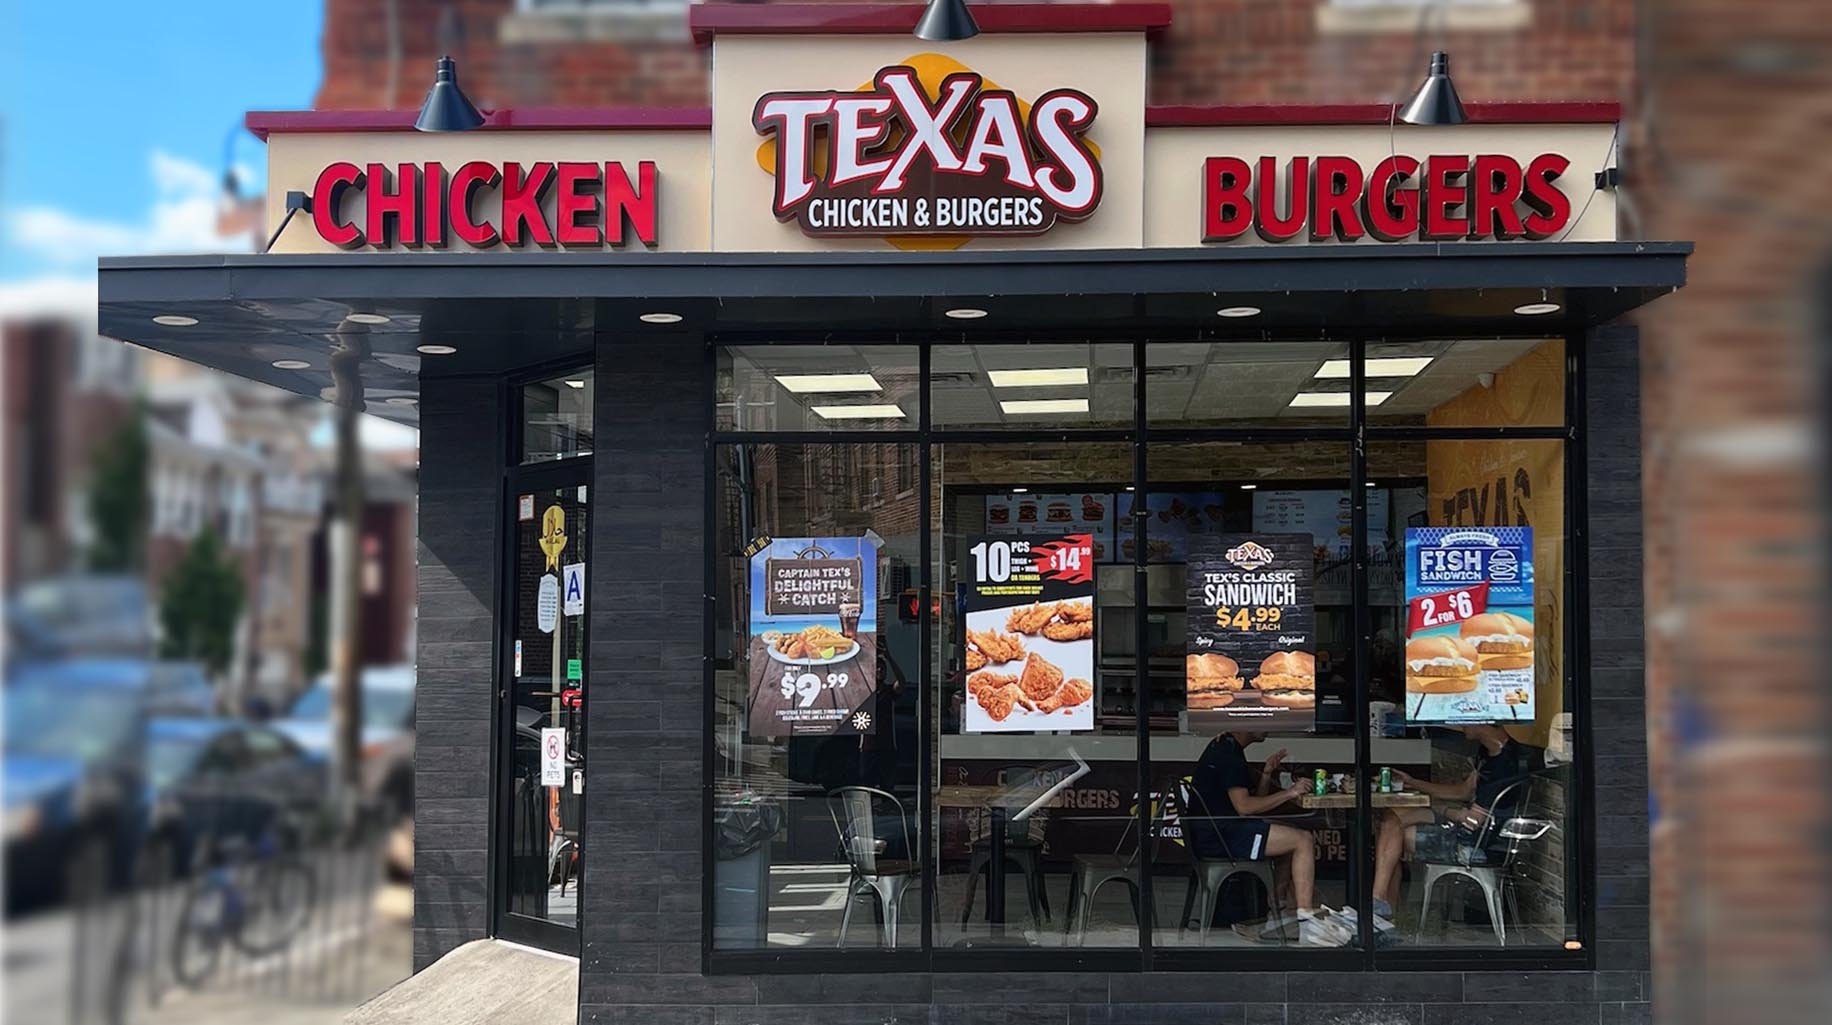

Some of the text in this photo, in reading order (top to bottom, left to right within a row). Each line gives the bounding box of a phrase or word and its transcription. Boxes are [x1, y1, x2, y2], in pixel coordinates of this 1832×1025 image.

[758, 71, 1099, 210] TEXAS
[312, 161, 659, 248] CHICKEN
[1202, 153, 1571, 242] BURGERS
[807, 196, 1044, 228] CHICKEN & BURGERS
[970, 541, 1030, 583] 10 PCS
[1226, 546, 1273, 564] TEXAS
[1420, 550, 1482, 571] FISH
[778, 567, 851, 578] CAPTAIN TEX'S
[1205, 573, 1296, 583] TEX'S CLASSIC
[1421, 571, 1482, 580] SANDWICH
[566, 571, 582, 602] A
[774, 579, 855, 593] DELIGHTFUL
[1204, 583, 1296, 606] SANDWICH
[791, 592, 836, 607] CATCH
[1421, 591, 1473, 626] 2 FOR $6
[1256, 623, 1281, 631] EACH
[1196, 636, 1213, 647] Spicy
[1279, 635, 1305, 646] Original
[781, 672, 848, 707] $9.99
[1049, 788, 1121, 809] URGERS
[1150, 825, 1183, 838] CICKEN
